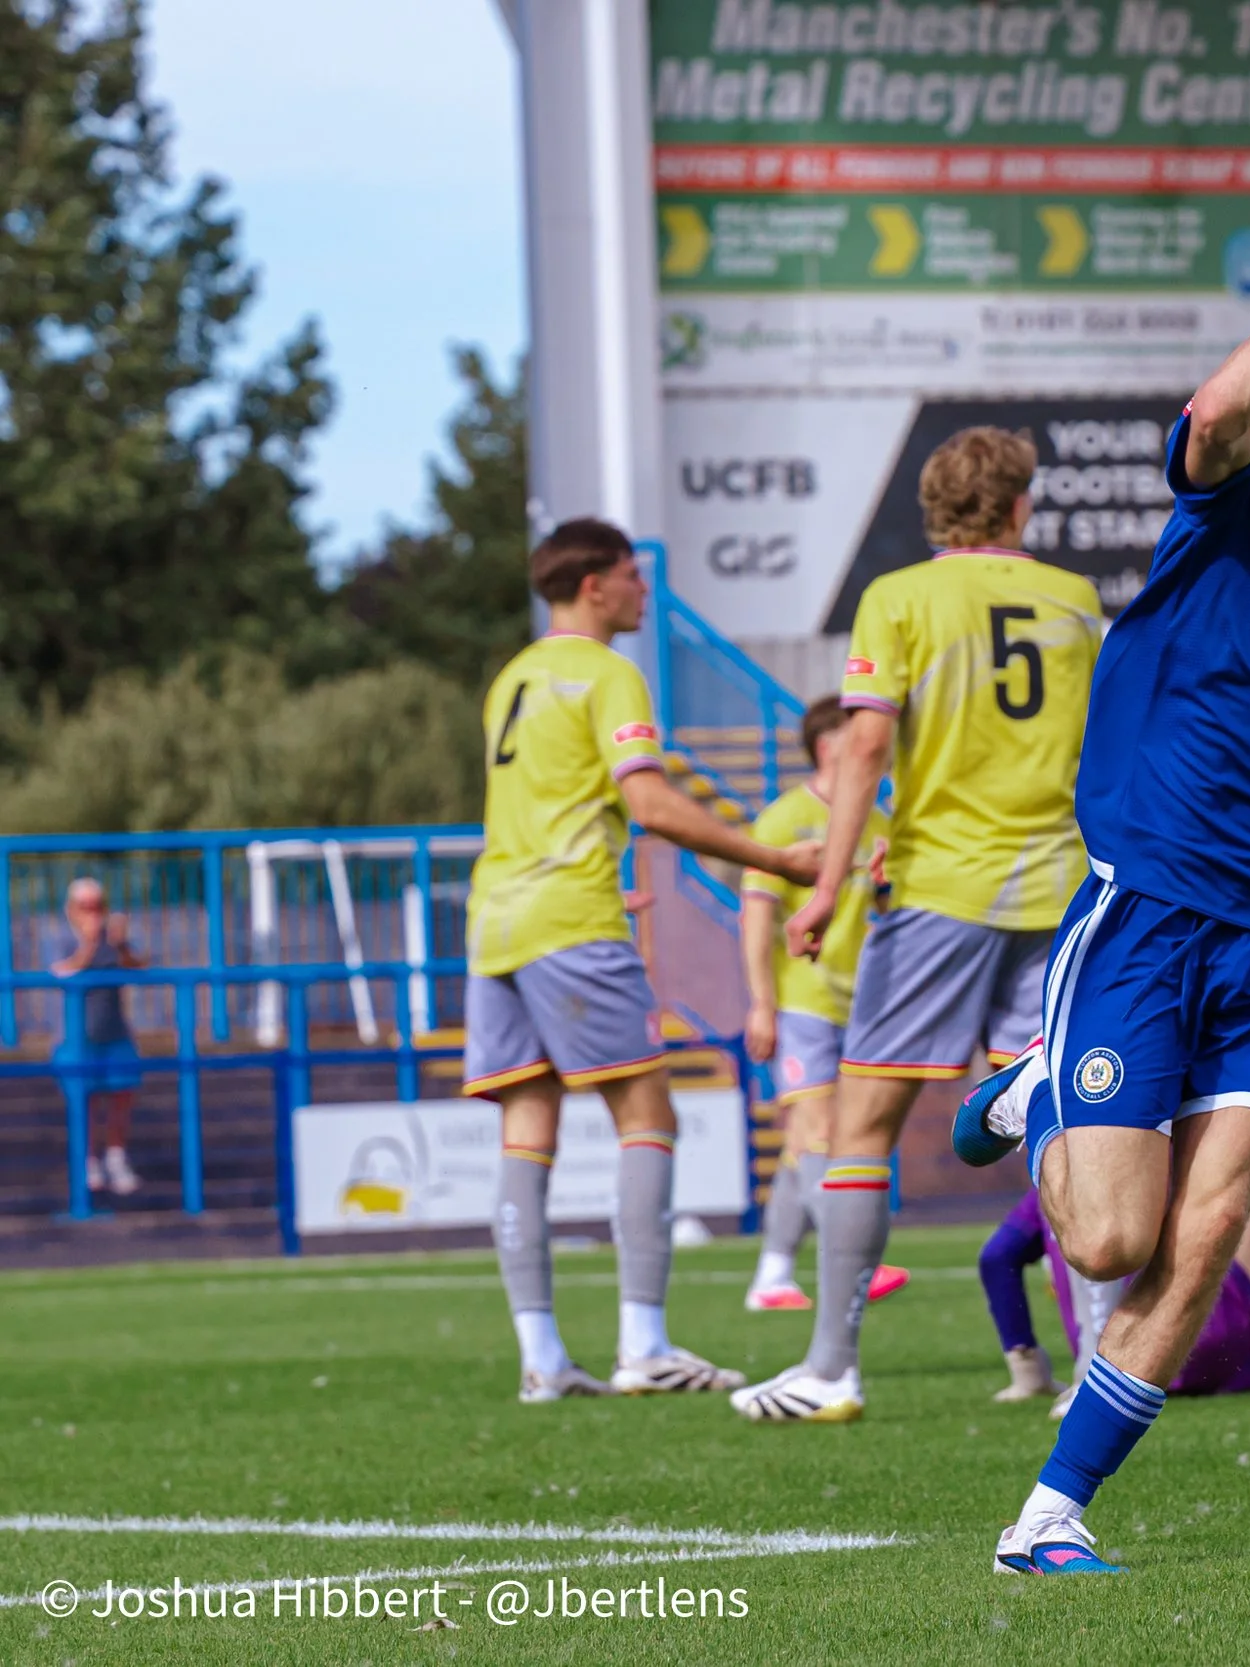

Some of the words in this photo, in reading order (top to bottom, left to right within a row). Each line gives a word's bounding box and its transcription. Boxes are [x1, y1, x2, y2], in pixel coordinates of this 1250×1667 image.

[711, 0, 1100, 56] Manchester's
[1116, 0, 1206, 54] No.
[655, 58, 830, 123] Metal
[838, 60, 1129, 136] Recycling
[1048, 419, 1163, 461] YOUR
[681, 458, 817, 500] UCFB
[1068, 509, 1174, 551] STAR
[991, 606, 1045, 720] 5
